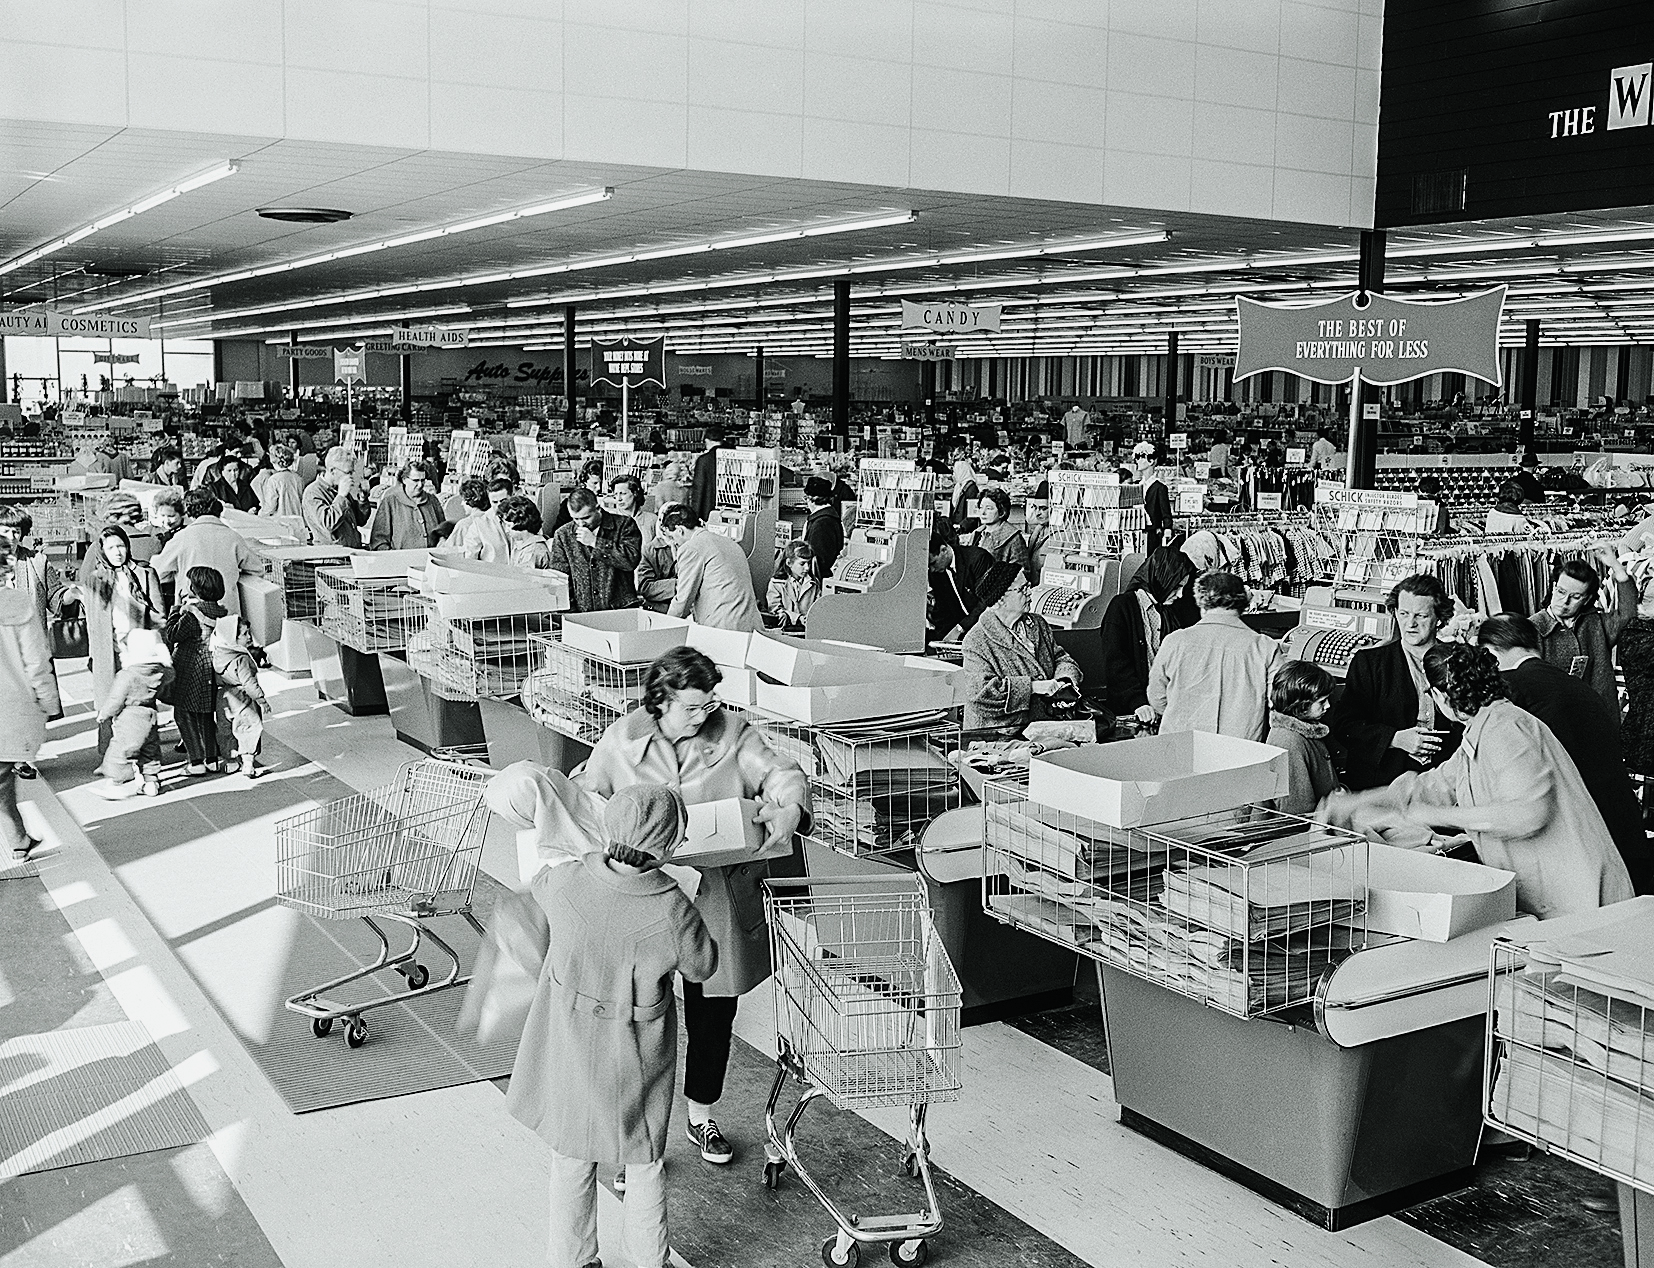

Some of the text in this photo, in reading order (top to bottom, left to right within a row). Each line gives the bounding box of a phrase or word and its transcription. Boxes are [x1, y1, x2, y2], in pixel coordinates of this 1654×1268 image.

[1548, 72, 1650, 139] THE W
[923, 309, 980, 326] CANDY
[61, 318, 138, 334] COSMETICS
[1317, 319, 1407, 338] THE BEST OF
[398, 330, 464, 343] HEALTH AIDS
[282, 347, 328, 357] PARTY GOODS
[365, 341, 400, 352] GREETING
[928, 347, 950, 358] WEAR
[1295, 340, 1429, 359] EVERYTHING FOR LESS
[1216, 357, 1235, 366] WEAR
[464, 359, 511, 382] Auto
[514, 361, 590, 386] Suppes
[867, 460, 887, 469] SCHICK
[1057, 472, 1082, 483] SCHICK
[1328, 490, 1363, 503] SCHICK
